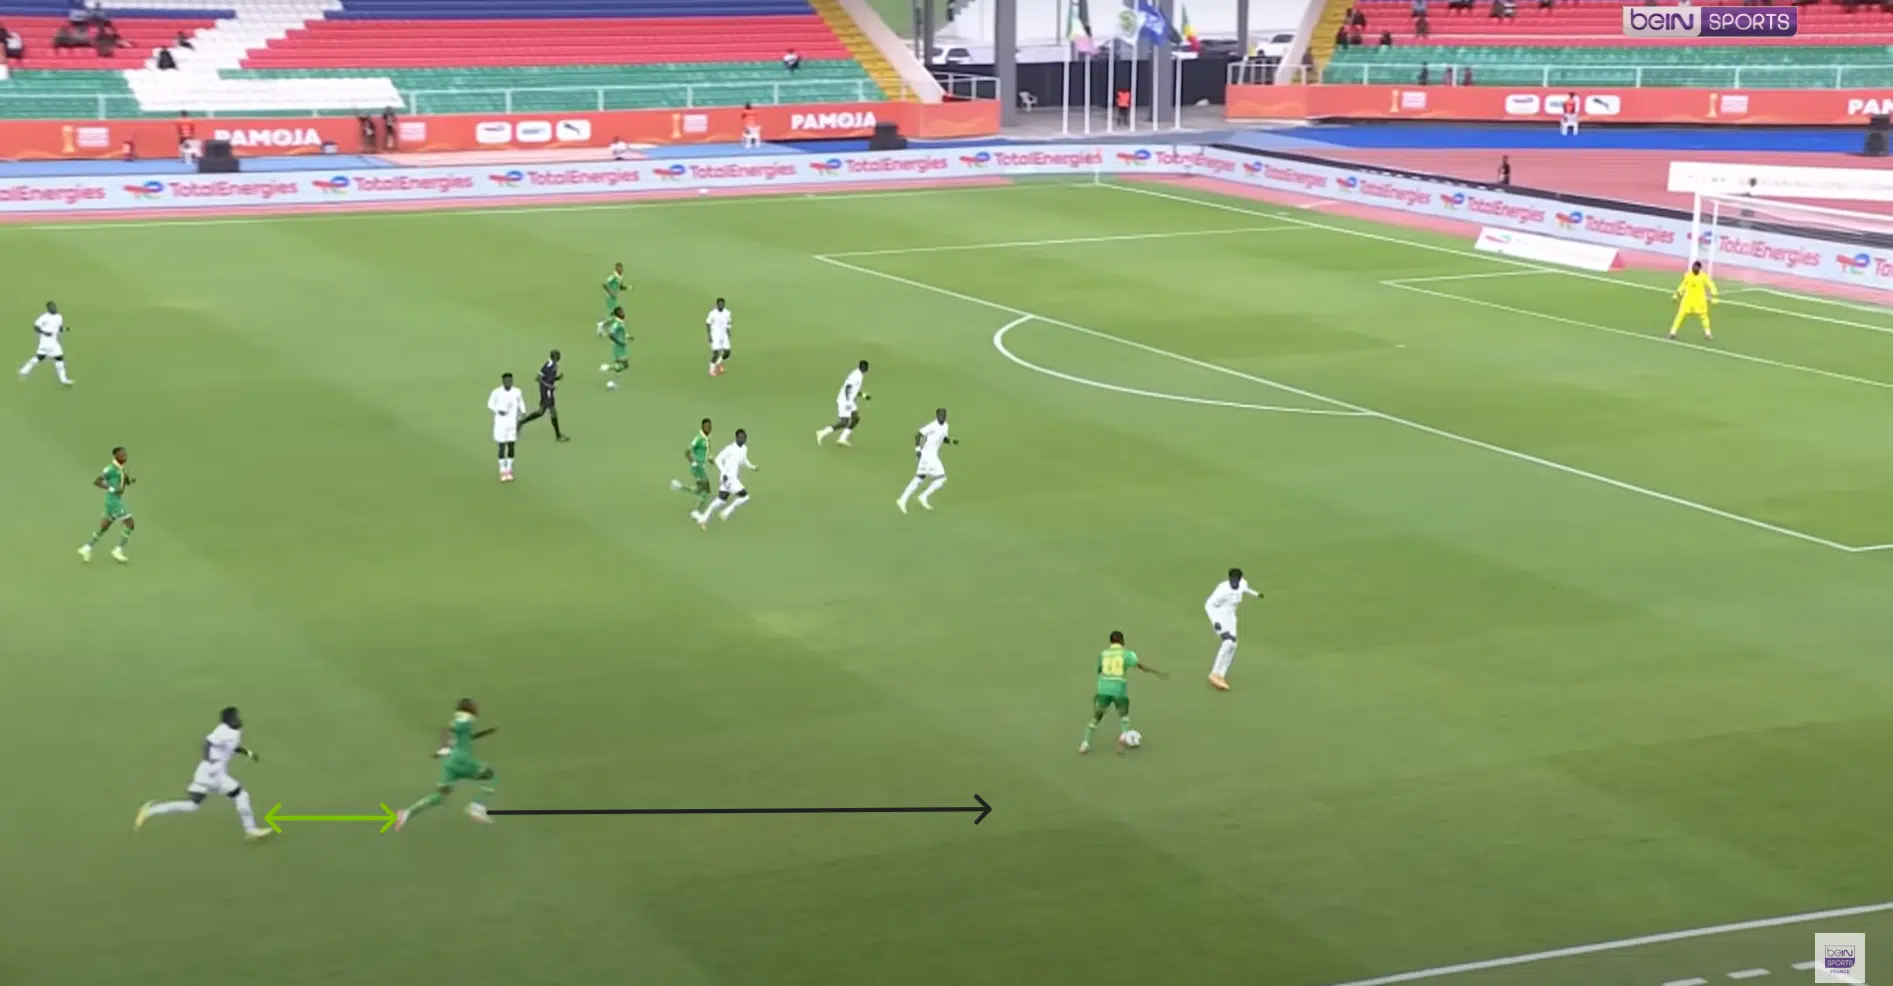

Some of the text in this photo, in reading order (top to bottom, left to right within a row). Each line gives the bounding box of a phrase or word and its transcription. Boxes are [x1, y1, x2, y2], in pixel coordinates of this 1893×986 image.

[791, 111, 876, 131] PAMOJA
[213, 128, 321, 146] PAMOJA
[689, 162, 796, 180] TotalEnergies
[846, 157, 948, 173] TotalEnergies
[353, 174, 473, 193] TotalEnergies
[527, 168, 640, 185] TotalEnergies
[168, 180, 298, 199] TotalEnergies
[1719, 235, 1820, 268] TotalEnergies
